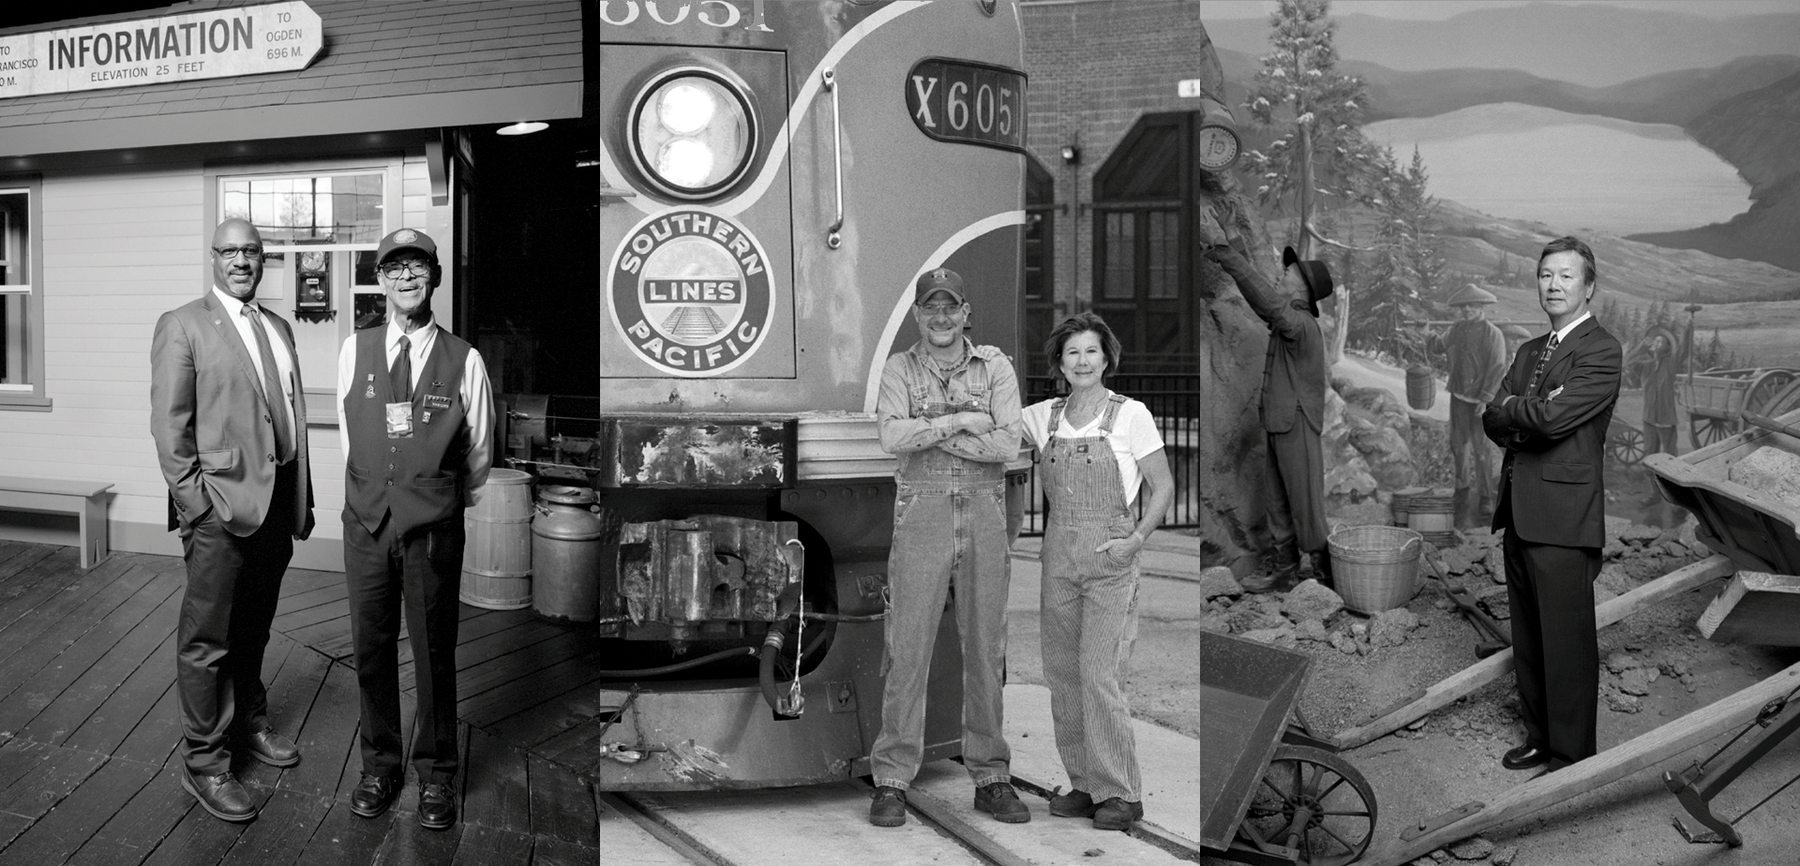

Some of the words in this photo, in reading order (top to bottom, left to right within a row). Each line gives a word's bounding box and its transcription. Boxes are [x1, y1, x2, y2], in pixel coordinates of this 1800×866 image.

[277, 12, 292, 23] TO
[49, 16, 253, 70] INFORMATION
[266, 29, 303, 42] OGDEN
[0, 46, 10, 56] TO
[267, 48, 288, 60] 696
[291, 47, 304, 57] M.
[91, 67, 148, 82] ELEVATION
[156, 65, 170, 75] 25
[177, 61, 205, 73] FEET
[7, 77, 17, 87] M.
[620, 213, 764, 276] SOUTHERN
[650, 282, 736, 301] LINES
[627, 319, 758, 369] PACIFIC
